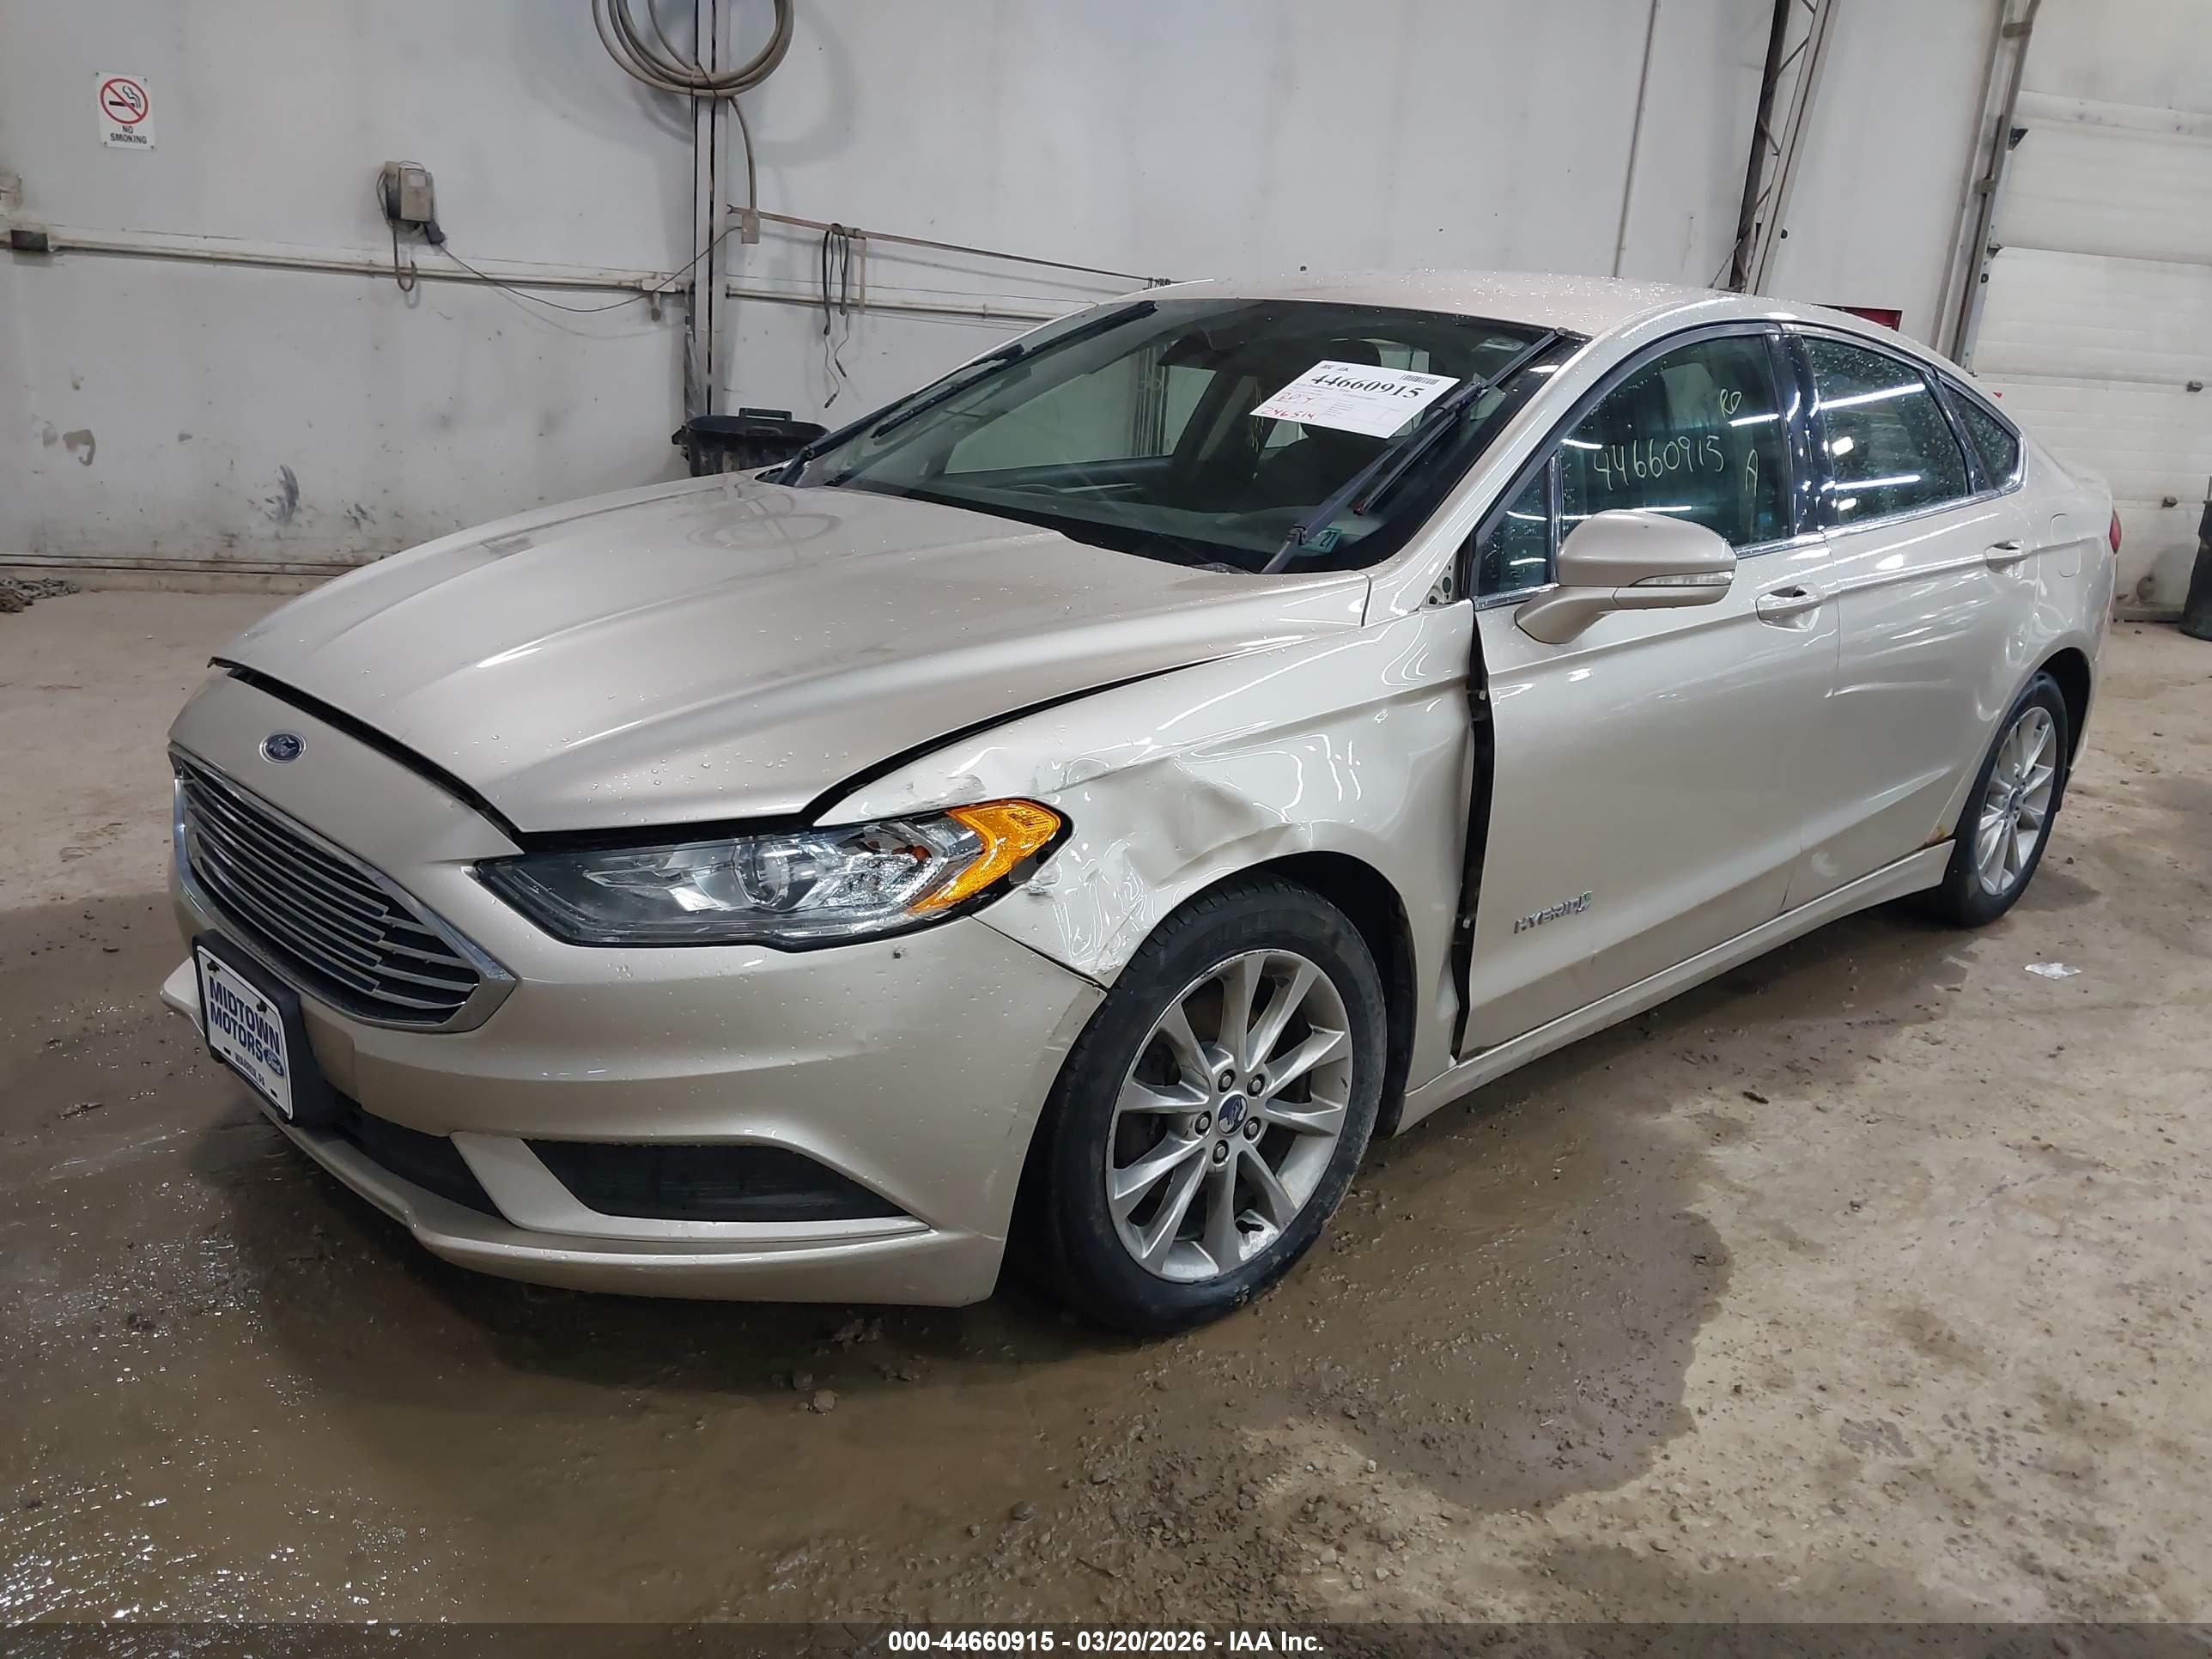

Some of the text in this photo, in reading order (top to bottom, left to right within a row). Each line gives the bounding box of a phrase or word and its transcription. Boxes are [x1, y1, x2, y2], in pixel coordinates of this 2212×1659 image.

[110, 132, 148, 144] SMOKING
[122, 125, 134, 134] NO
[1310, 374, 1425, 398] 44660915
[1594, 436, 1759, 498] 44660915 A
[209, 975, 280, 1056] MIDTOWN
[210, 1001, 264, 1063] MOTORS
